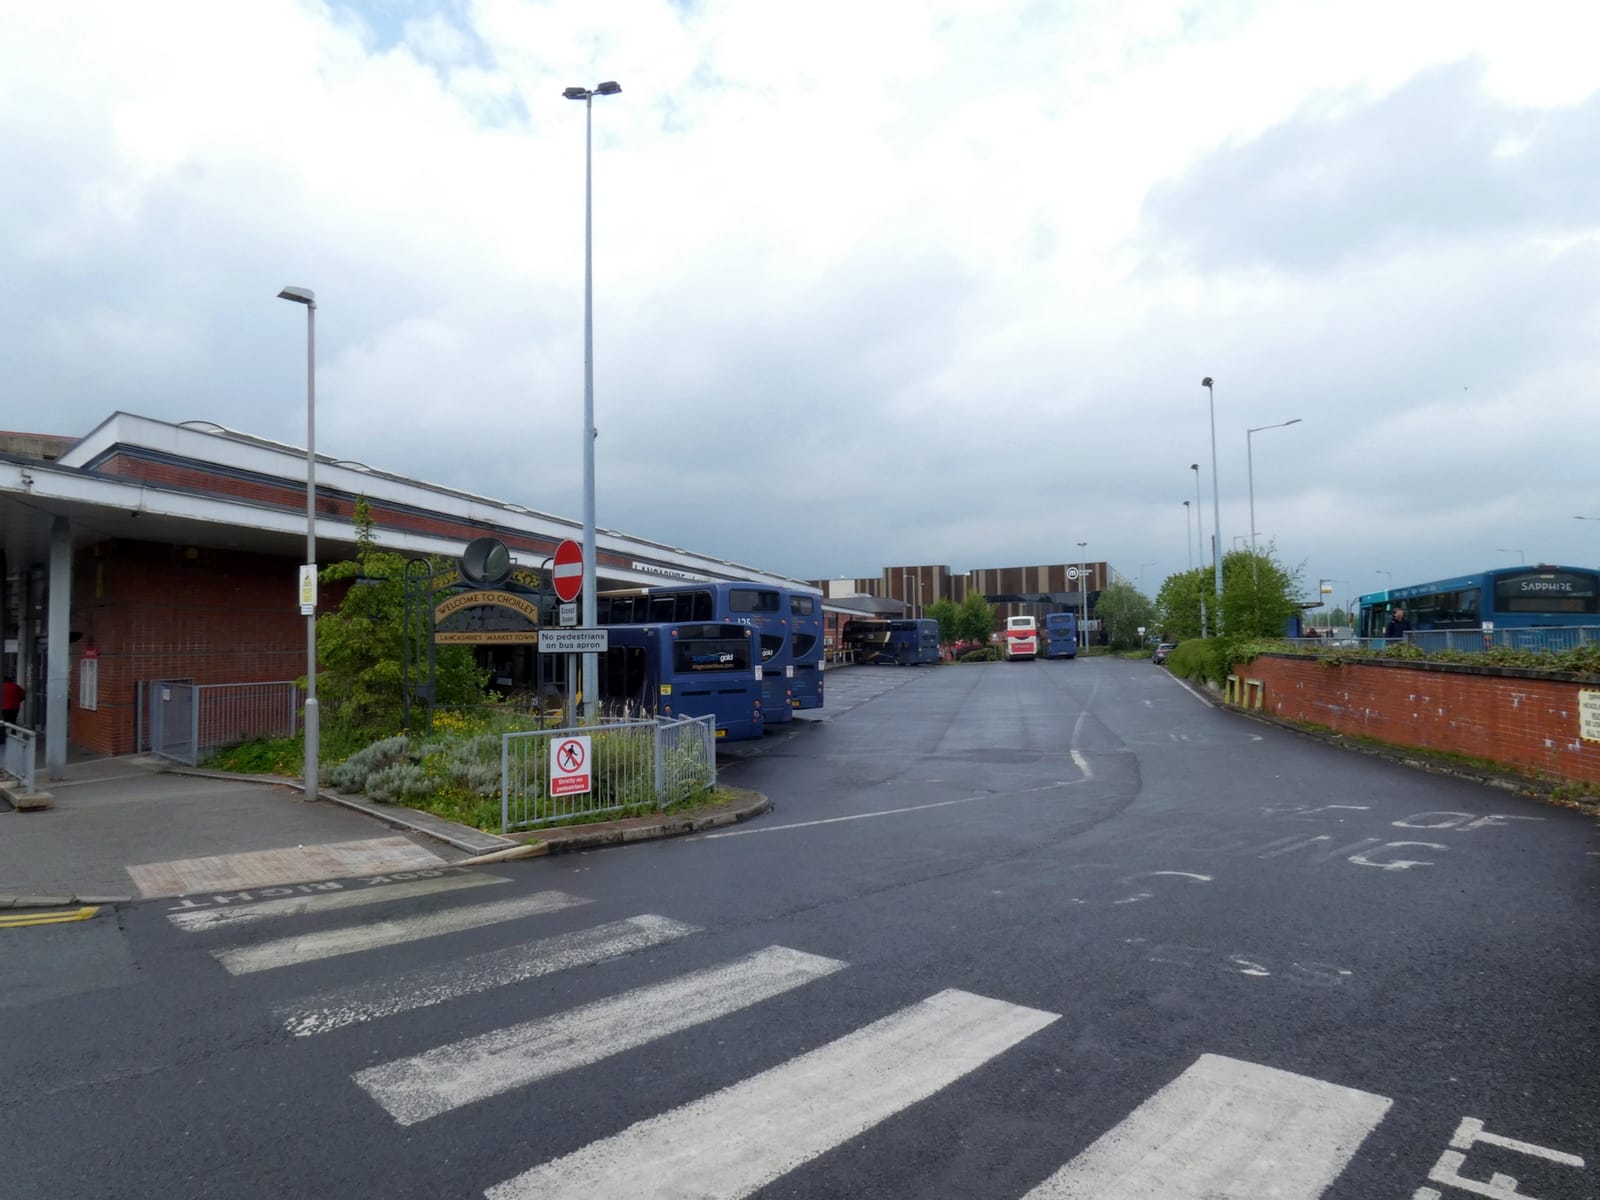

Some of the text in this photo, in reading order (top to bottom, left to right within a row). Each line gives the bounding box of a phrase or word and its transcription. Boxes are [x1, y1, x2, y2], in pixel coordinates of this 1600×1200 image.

[1521, 581, 1573, 591] SAPPHIRE
[438, 593, 536, 615] WELCOME TO CHORLEY
[542, 632, 605, 642] No pedestrians
[576, 642, 601, 650] apron
[719, 653, 734, 662] gold
[761, 648, 774, 657] gold
[168, 881, 344, 911] RIGHT
